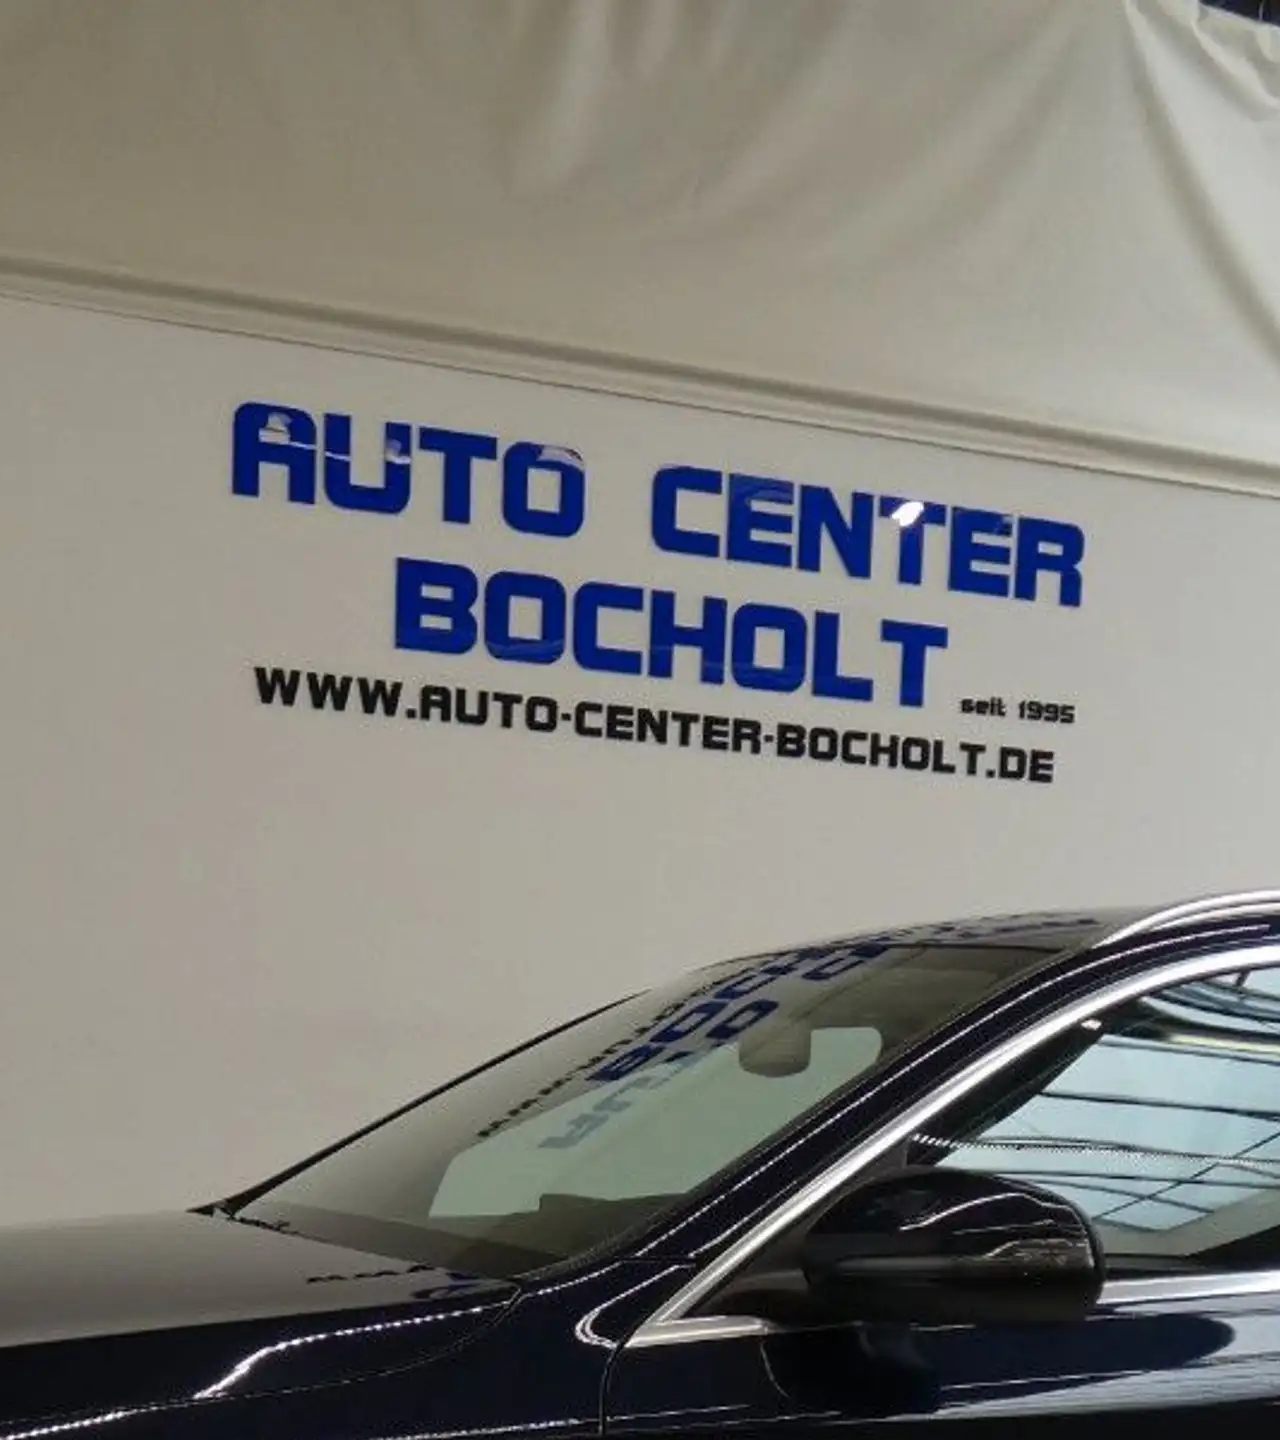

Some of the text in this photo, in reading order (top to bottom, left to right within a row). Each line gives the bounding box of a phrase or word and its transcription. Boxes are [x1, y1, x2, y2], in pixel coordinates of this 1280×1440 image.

[231, 402, 1085, 607] AUTO CENTER
[394, 557, 948, 708] BOCHOLT
[254, 666, 1055, 783] WWW.AUTO-CENTER-BOCHOLT.DE
[960, 696, 1076, 724] seit 1995
